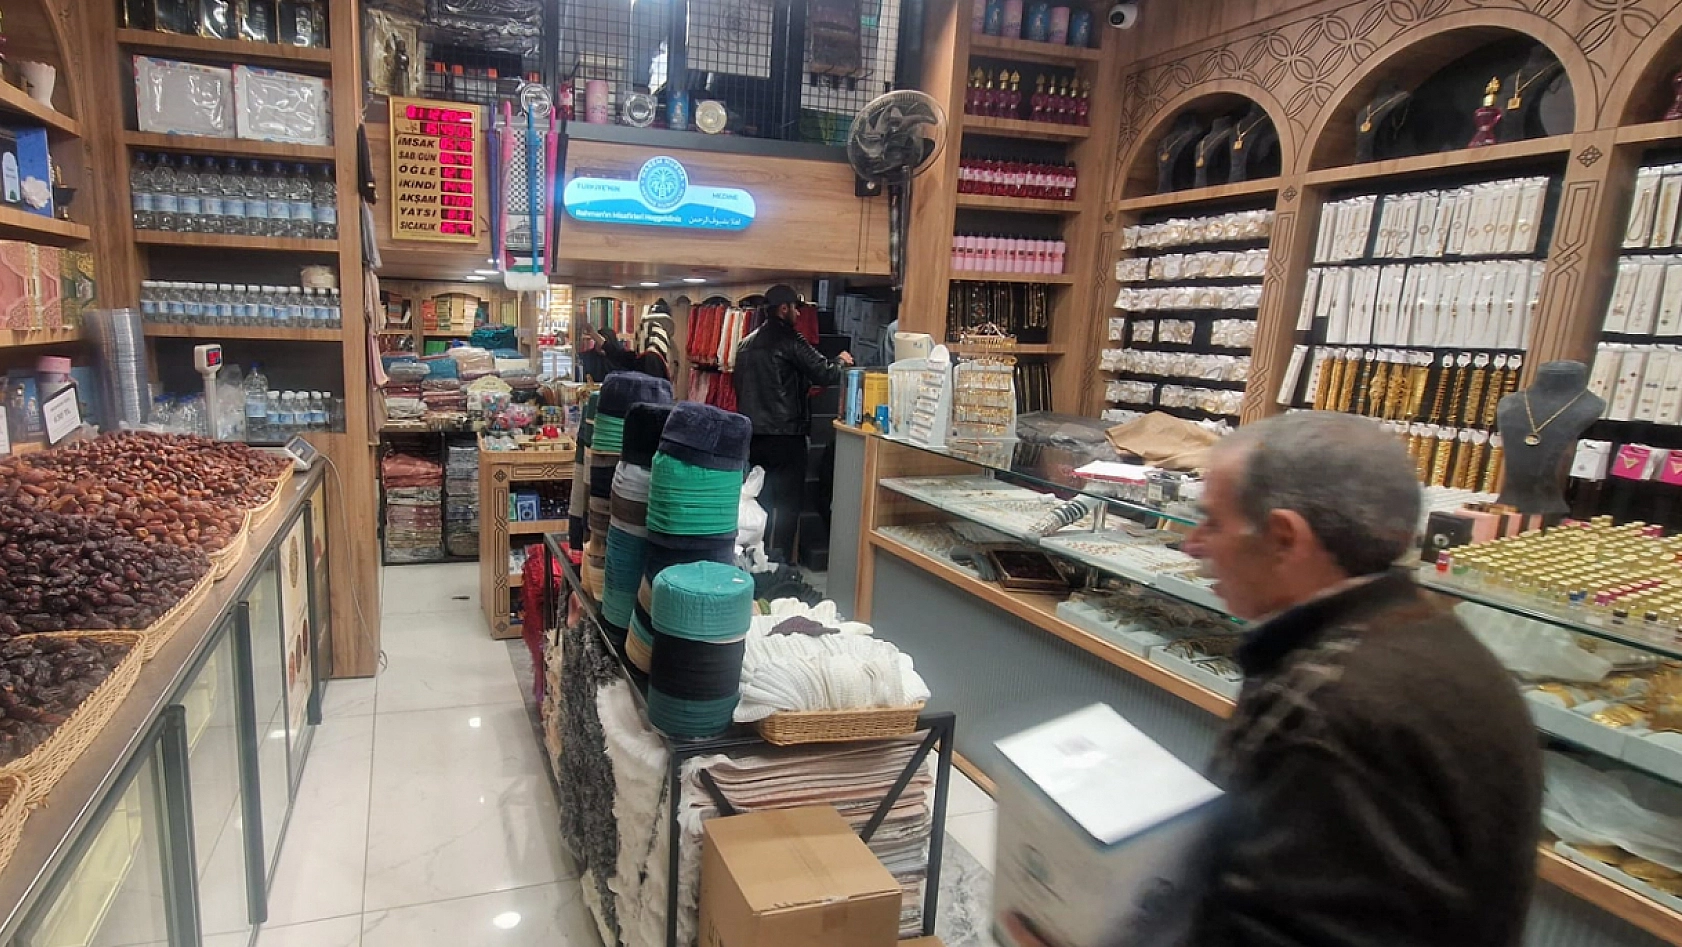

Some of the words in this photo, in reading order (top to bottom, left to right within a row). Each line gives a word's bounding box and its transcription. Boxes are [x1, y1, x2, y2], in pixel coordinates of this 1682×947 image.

[399, 163, 437, 176] ÖĞLE
[399, 193, 437, 204] AKŞAM
[400, 207, 437, 217] YATSI
